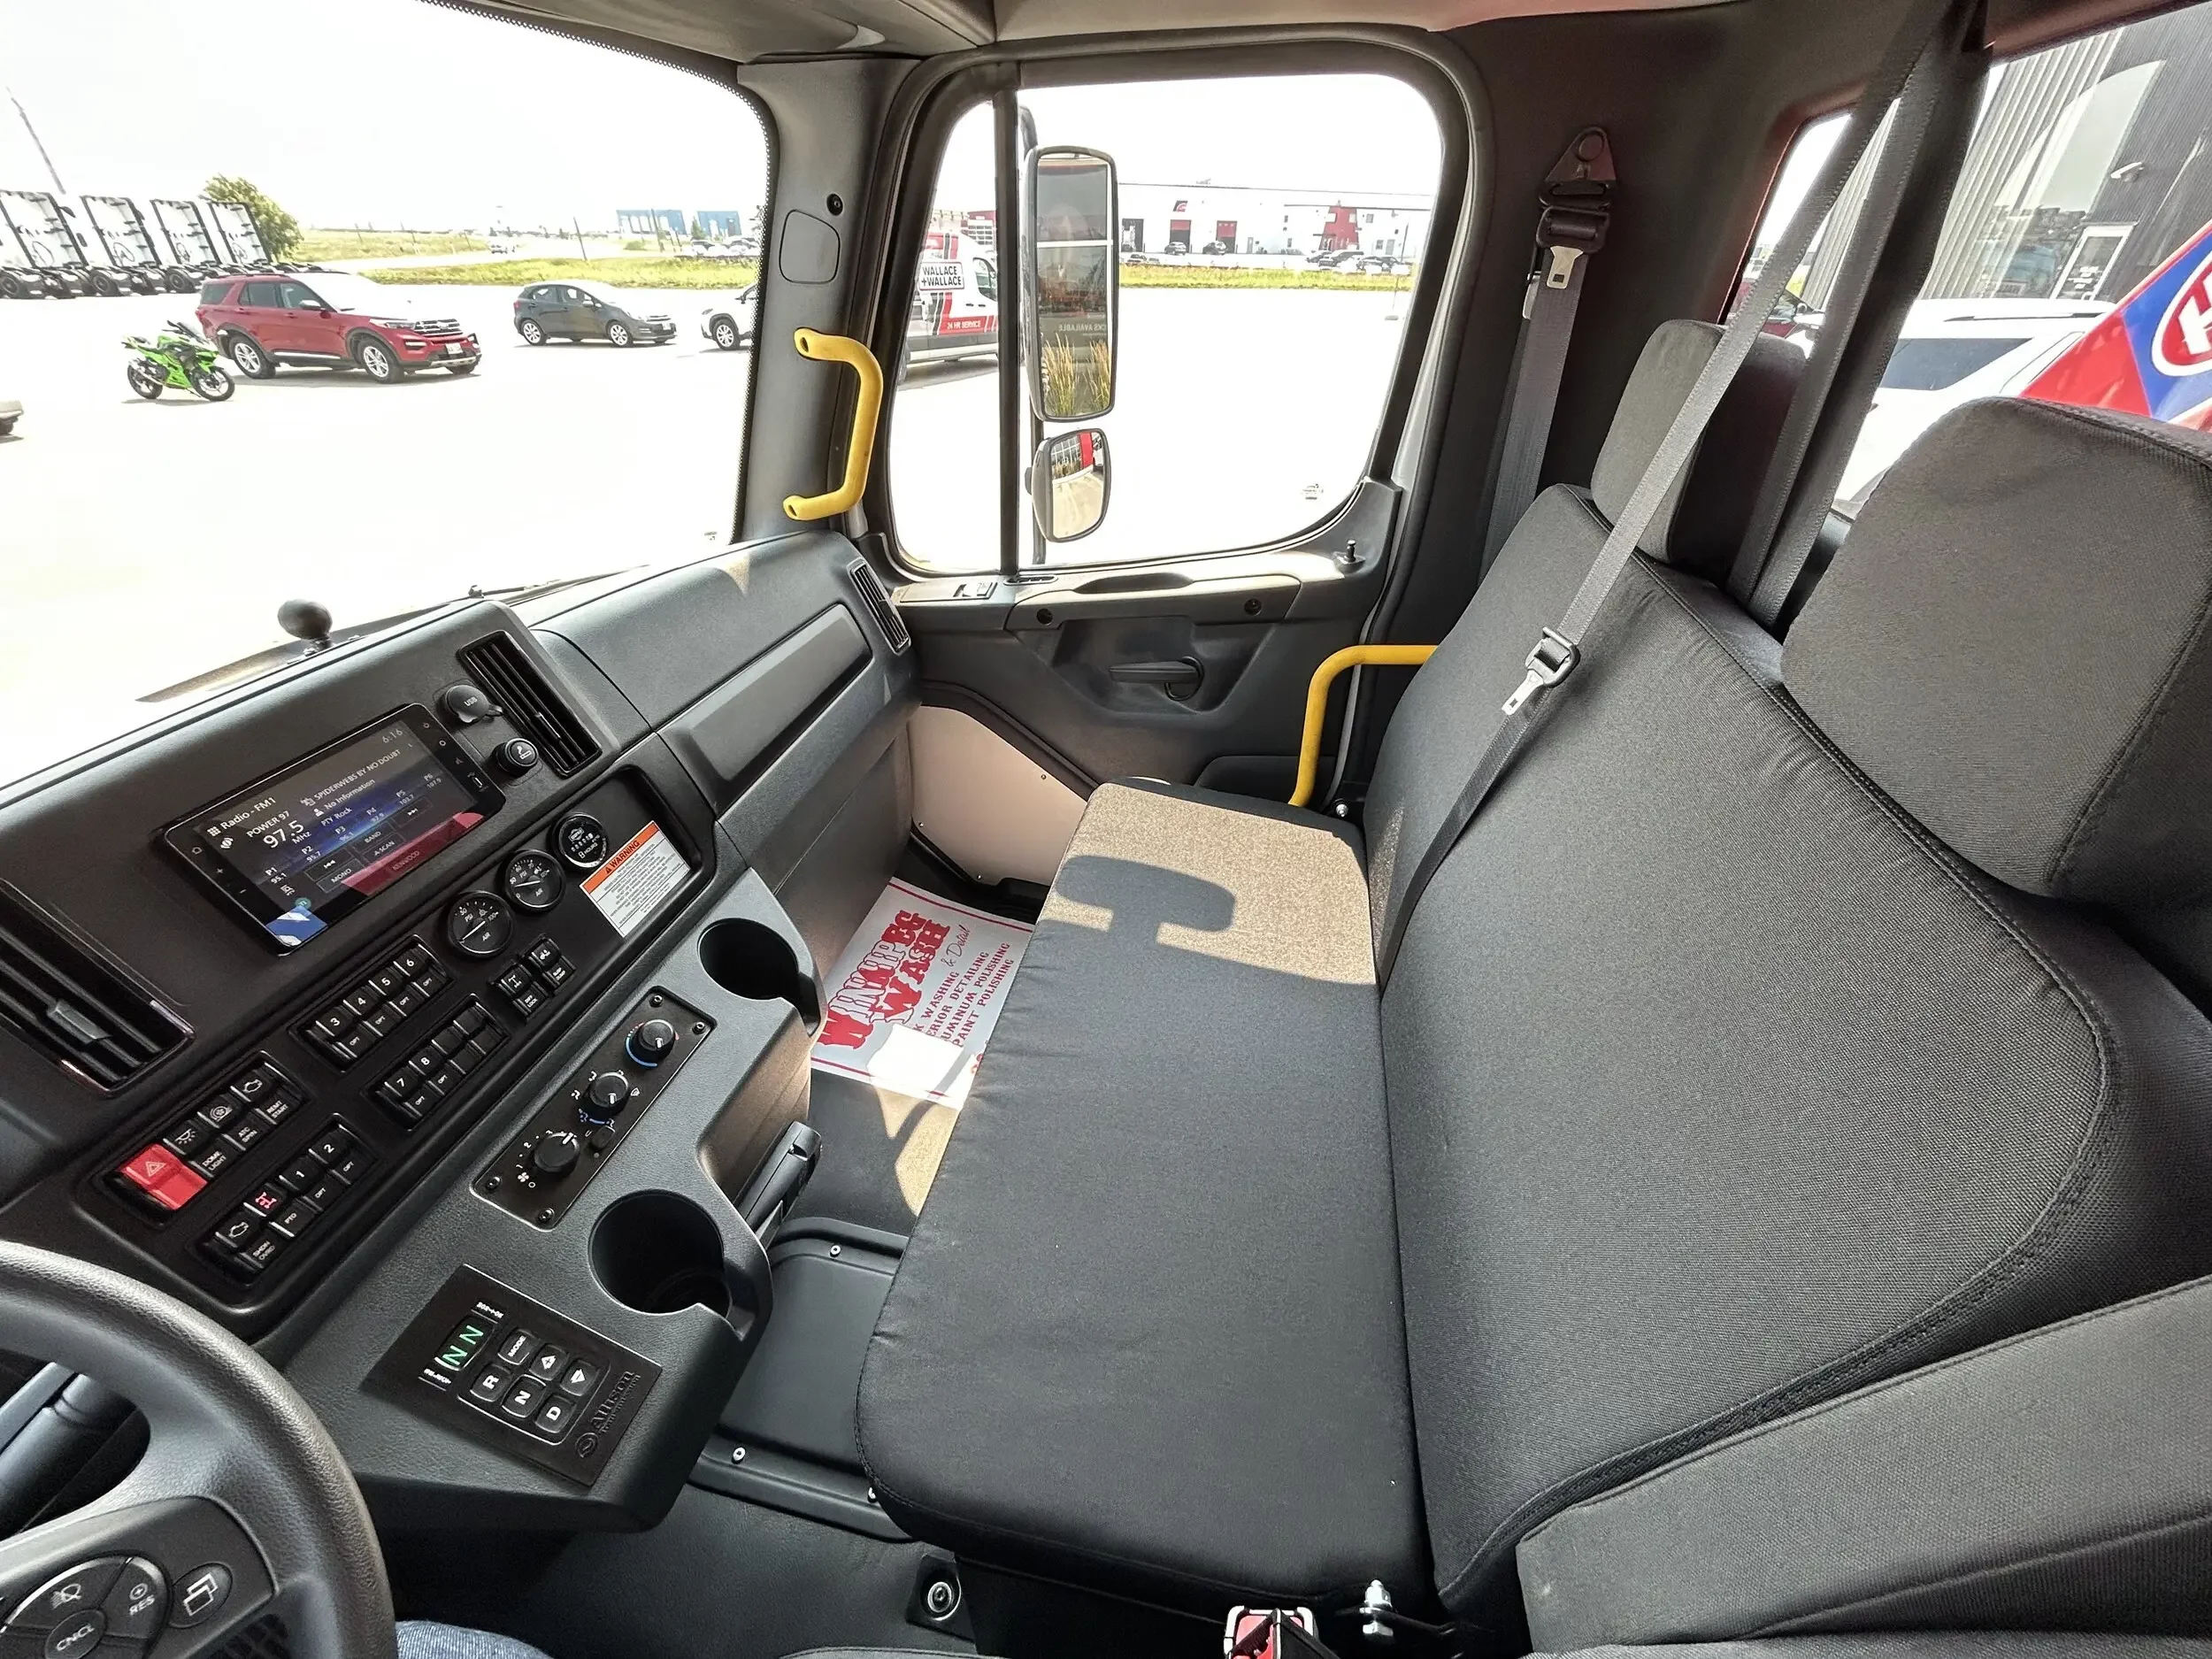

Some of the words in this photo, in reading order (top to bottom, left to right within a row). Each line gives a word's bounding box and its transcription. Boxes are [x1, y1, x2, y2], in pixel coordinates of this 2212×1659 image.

[922, 266, 957, 275] WALLACE
[464, 696, 478, 707] USB
[382, 728, 403, 744] 6:16
[314, 773, 357, 801] SPIDERWEBS
[357, 768, 367, 777] BY
[367, 761, 379, 772] NO
[378, 749, 402, 765] DOUBT
[324, 799, 336, 810] No
[336, 779, 376, 804] Information
[219, 812, 250, 830] Radio
[253, 797, 276, 811] FM1
[320, 817, 334, 826] PTY
[334, 807, 353, 819] Rock
[246, 816, 281, 838] POWER
[278, 810, 290, 820] 97
[264, 819, 304, 849] 97.5
[265, 867, 277, 876] P1
[301, 845, 313, 855] P2
[334, 826, 346, 835] P3
[366, 807, 378, 816] P4
[396, 789, 406, 798] P5
[291, 832, 311, 844] MHz
[364, 831, 381, 843] BAND
[379, 840, 396, 852] SCAN
[584, 842, 598, 855] HOURS
[610, 841, 641, 868] WARNING
[271, 872, 287, 884] 95.1
[306, 851, 321, 863] 95.7
[330, 868, 352, 883] MONO
[465, 913, 473, 922] PSI
[482, 932, 491, 941] AIR
[946, 925, 971, 958] Detail
[406, 958, 414, 967] 6
[940, 958, 956, 967] &
[868, 919, 951, 1024] WASH
[423, 978, 433, 987] OPT
[921, 971, 959, 1019] WASHING
[926, 1005, 952, 1036] ERIOR
[952, 951, 989, 1003] DETAILING
[942, 995, 976, 1041] UMINUM
[976, 942, 1010, 987] POLISHING
[357, 997, 366, 1006] 4
[400, 996, 410, 1005] OPT
[526, 998, 538, 1008] LOCK
[953, 1013, 979, 1048] PAINT
[977, 958, 1014, 1007] POLISHING
[375, 1016, 386, 1025] OPT
[349, 1036, 360, 1046] OPT
[420, 1056, 430, 1065] 8
[396, 1078, 405, 1087] 7
[437, 1074, 448, 1085] OPT
[415, 1095, 426, 1106] OPT
[271, 1104, 288, 1118] START
[238, 1126, 250, 1137] ATC
[242, 1130, 257, 1143] SPIN
[324, 1144, 334, 1153] 2
[202, 1150, 222, 1167] DOME
[208, 1155, 227, 1171] LIGHT
[343, 1161, 354, 1171] OPT
[315, 1187, 326, 1198] OPT
[284, 1213, 297, 1224] PTO
[442, 1345, 468, 1365] N
[458, 1325, 484, 1345] N
[508, 1335, 527, 1357] MODE
[482, 1375, 500, 1390] R
[514, 1390, 531, 1405] N
[590, 1371, 635, 1429] Allison
[546, 1406, 561, 1421] D
[129, 1594, 156, 1616] RES
[56, 1624, 96, 1651] CNCL
